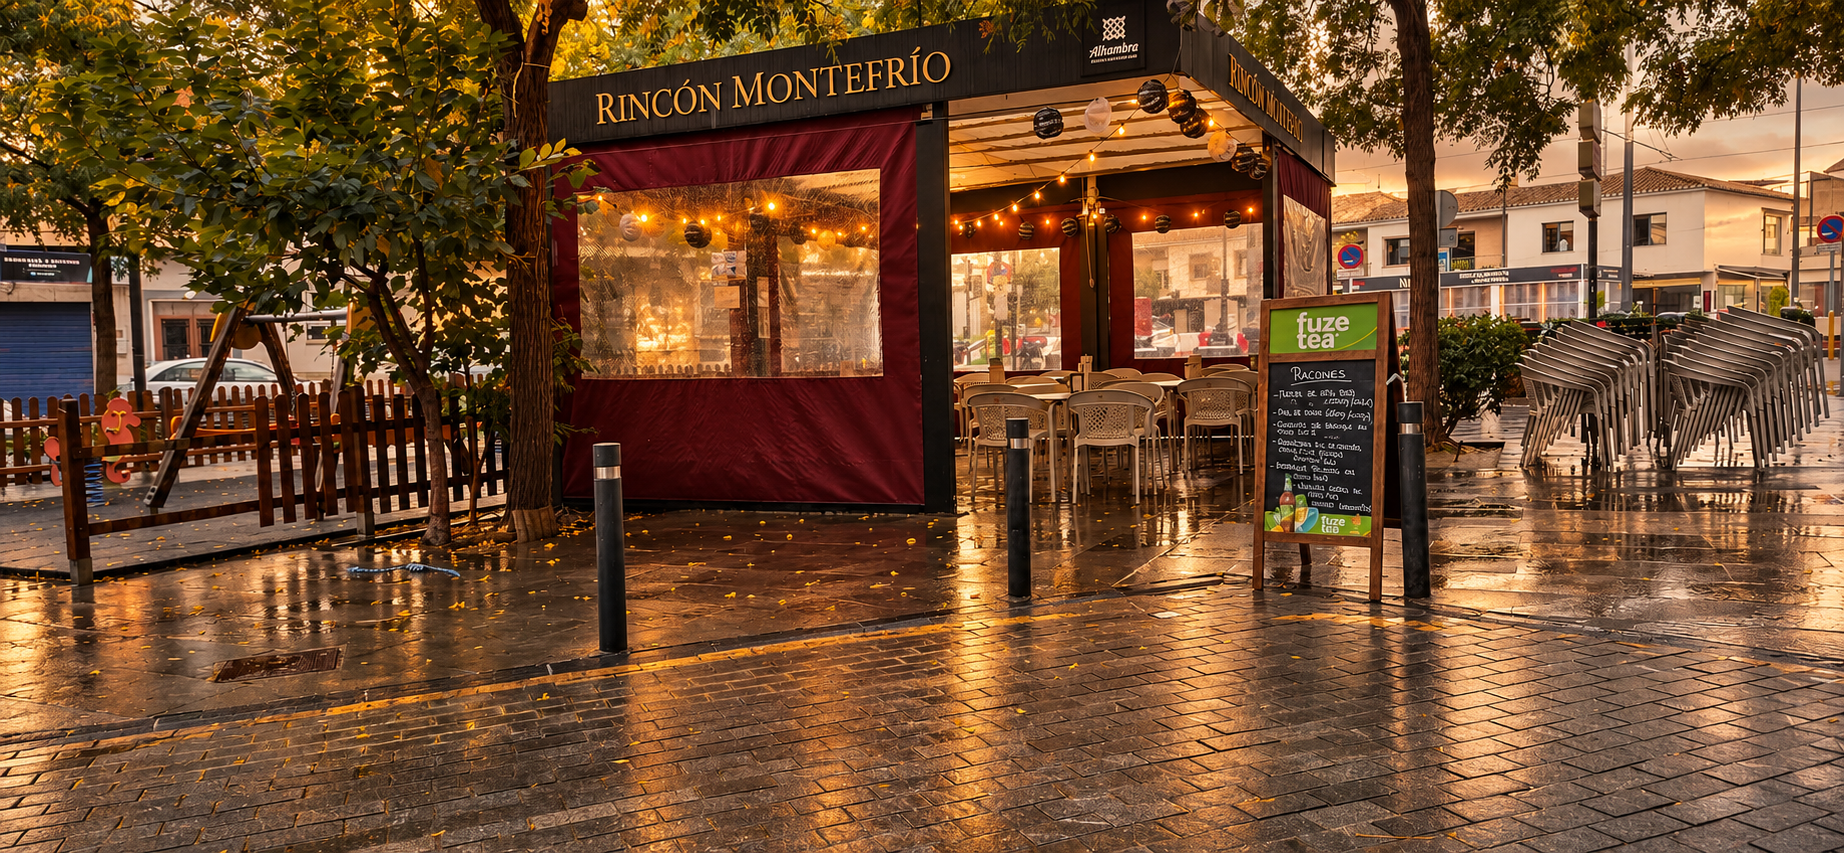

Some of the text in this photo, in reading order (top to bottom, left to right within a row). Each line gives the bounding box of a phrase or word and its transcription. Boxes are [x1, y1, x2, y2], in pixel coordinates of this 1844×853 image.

[1089, 42, 1139, 58] Alhambra
[595, 46, 952, 125] RINCÓN MONTEFRÍO
[1228, 52, 1265, 112] RINCÓN
[1296, 311, 1350, 333] fuze
[1296, 332, 1336, 349] tea
[1321, 515, 1346, 527] fuze
